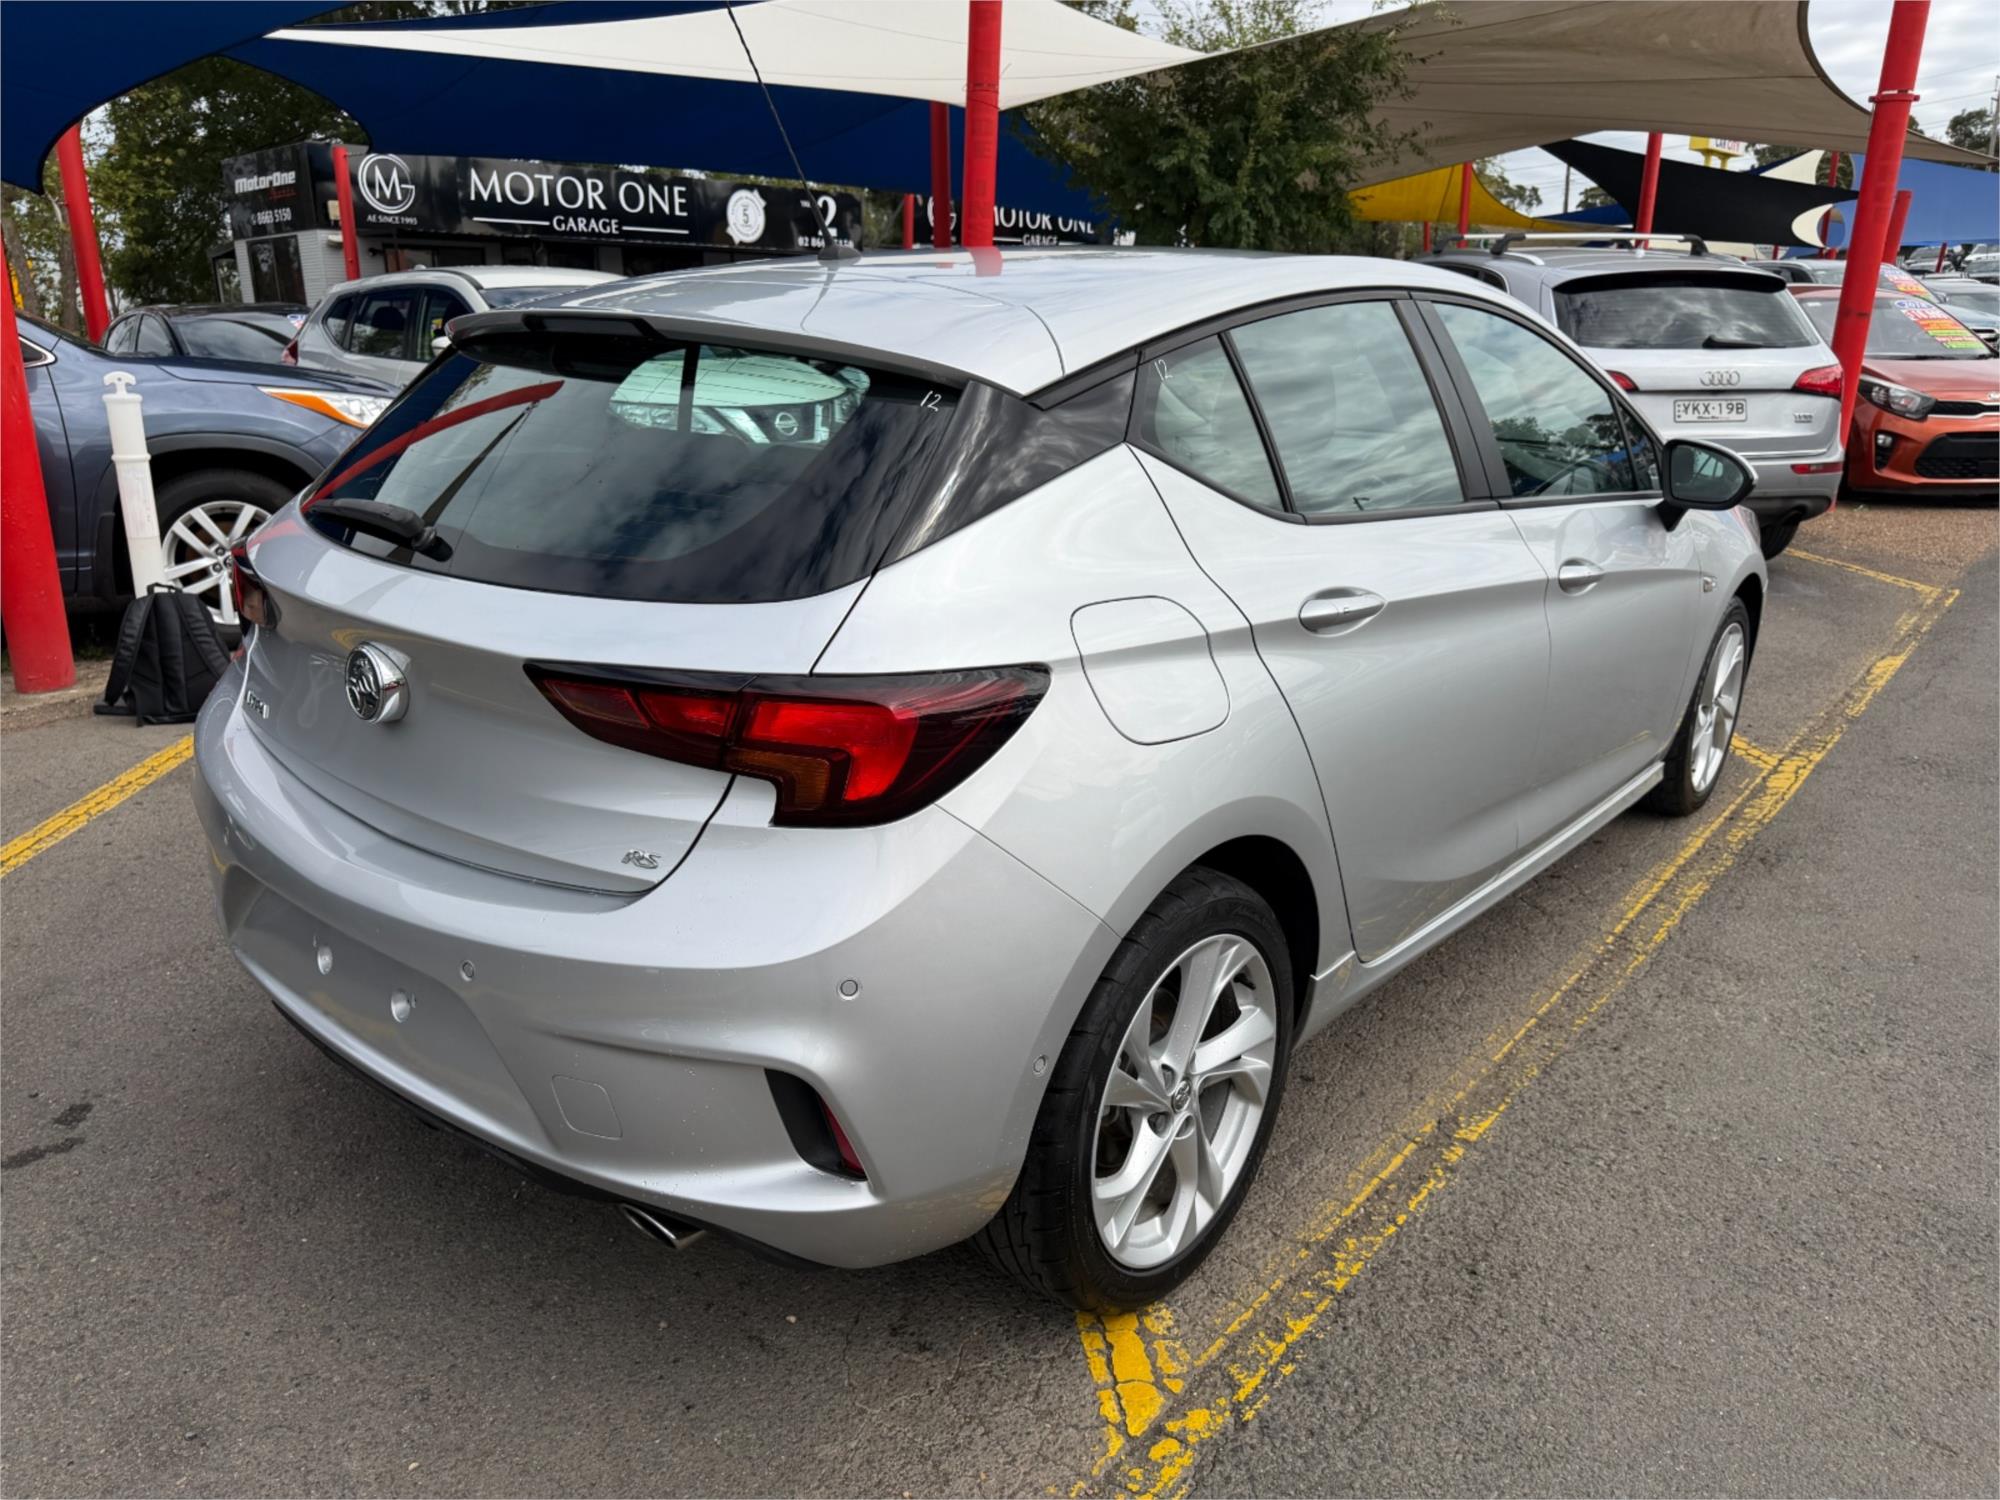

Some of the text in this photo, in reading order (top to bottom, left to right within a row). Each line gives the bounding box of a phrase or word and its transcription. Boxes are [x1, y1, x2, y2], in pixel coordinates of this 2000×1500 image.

[469, 167, 688, 216] MOTOR ONE
[378, 216, 400, 224] SINCE
[553, 215, 620, 234] GARAGE
[1022, 233, 1059, 247] GARAGE
[1155, 359, 1174, 381] 12
[920, 390, 943, 412] 12
